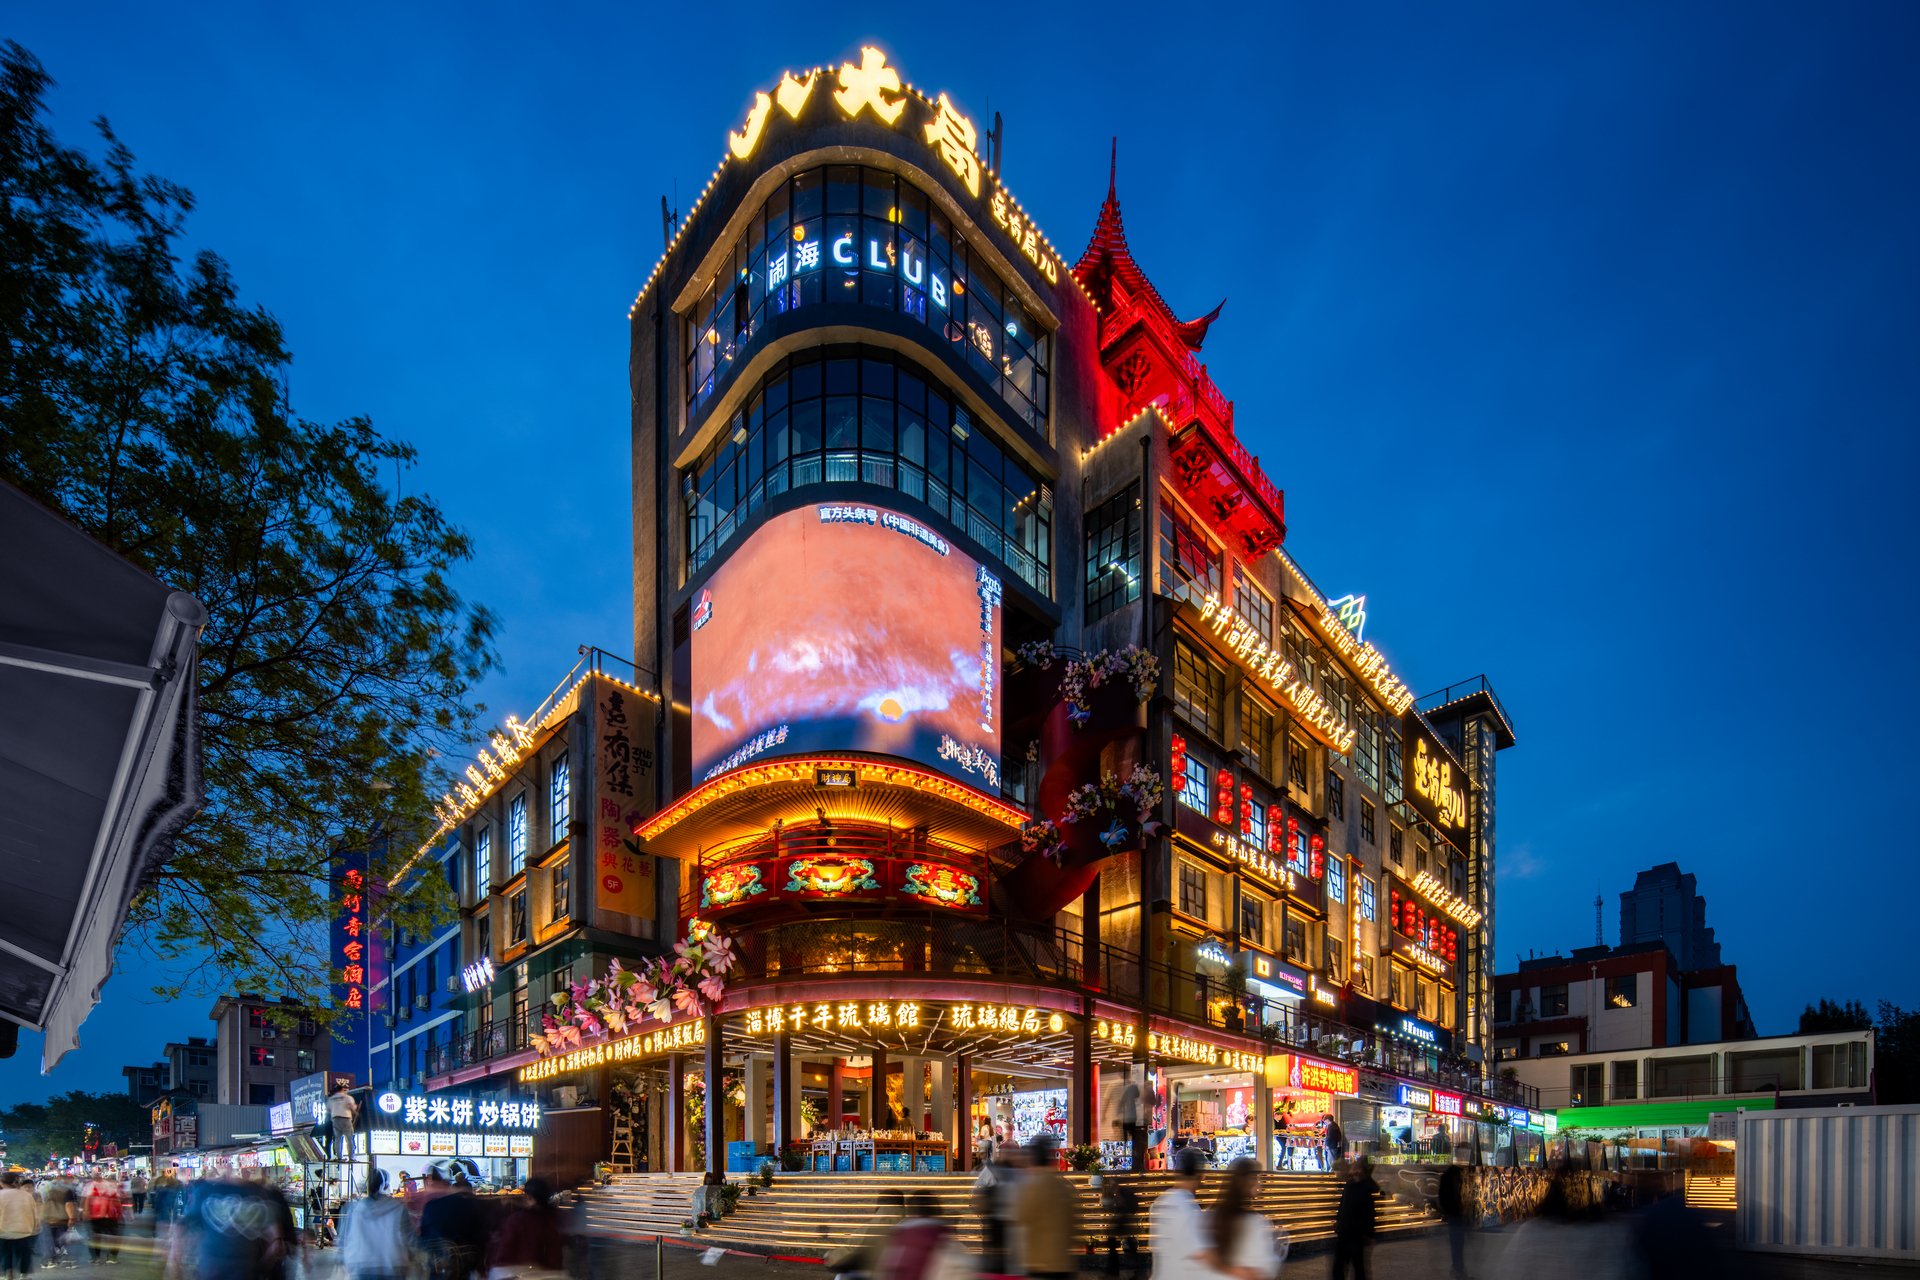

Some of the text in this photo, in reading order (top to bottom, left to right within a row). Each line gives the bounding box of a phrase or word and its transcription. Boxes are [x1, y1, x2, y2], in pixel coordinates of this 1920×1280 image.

[729, 45, 982, 198] 八大局
[768, 238, 950, 307] 闹海 CLUB
[820, 772, 852, 785] 財神局
[745, 1002, 1041, 1034] 淄博千年琉璃館 琉璃總局
[614, 1036, 641, 1061] 財神局
[404, 1097, 542, 1129] 紫米饼 炒锅饼
[175, 1115, 197, 1148] 酒店
